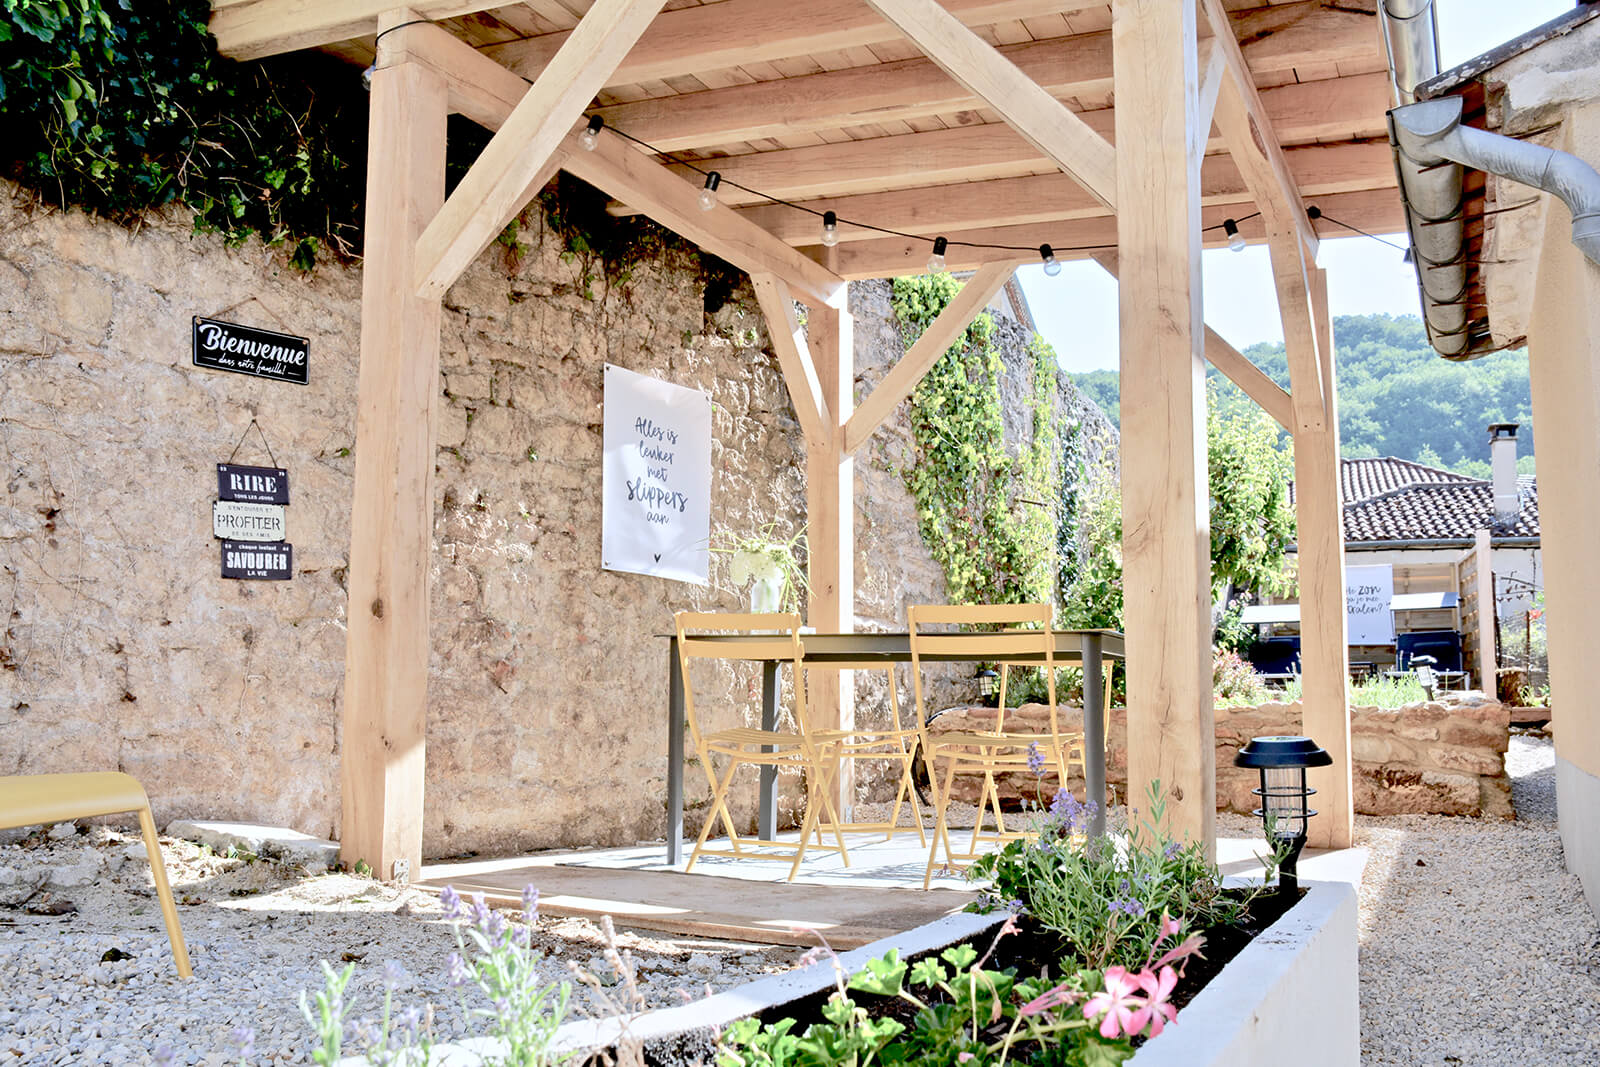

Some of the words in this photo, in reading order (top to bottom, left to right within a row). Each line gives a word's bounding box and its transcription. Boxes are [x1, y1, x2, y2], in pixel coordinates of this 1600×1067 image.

[199, 323, 305, 366] Bienvenue
[218, 352, 235, 367] dans
[635, 416, 664, 441] Alles
[666, 429, 678, 445] is
[639, 440, 674, 465] leuker
[647, 465, 668, 482] met
[230, 473, 277, 493] RIRE
[217, 514, 281, 531] PROFITER
[646, 511, 669, 525] aan
[238, 543, 257, 551] chaque
[227, 551, 287, 570] SAVOURER
[1358, 585, 1381, 595] zon
[1347, 603, 1383, 614] tralen?
